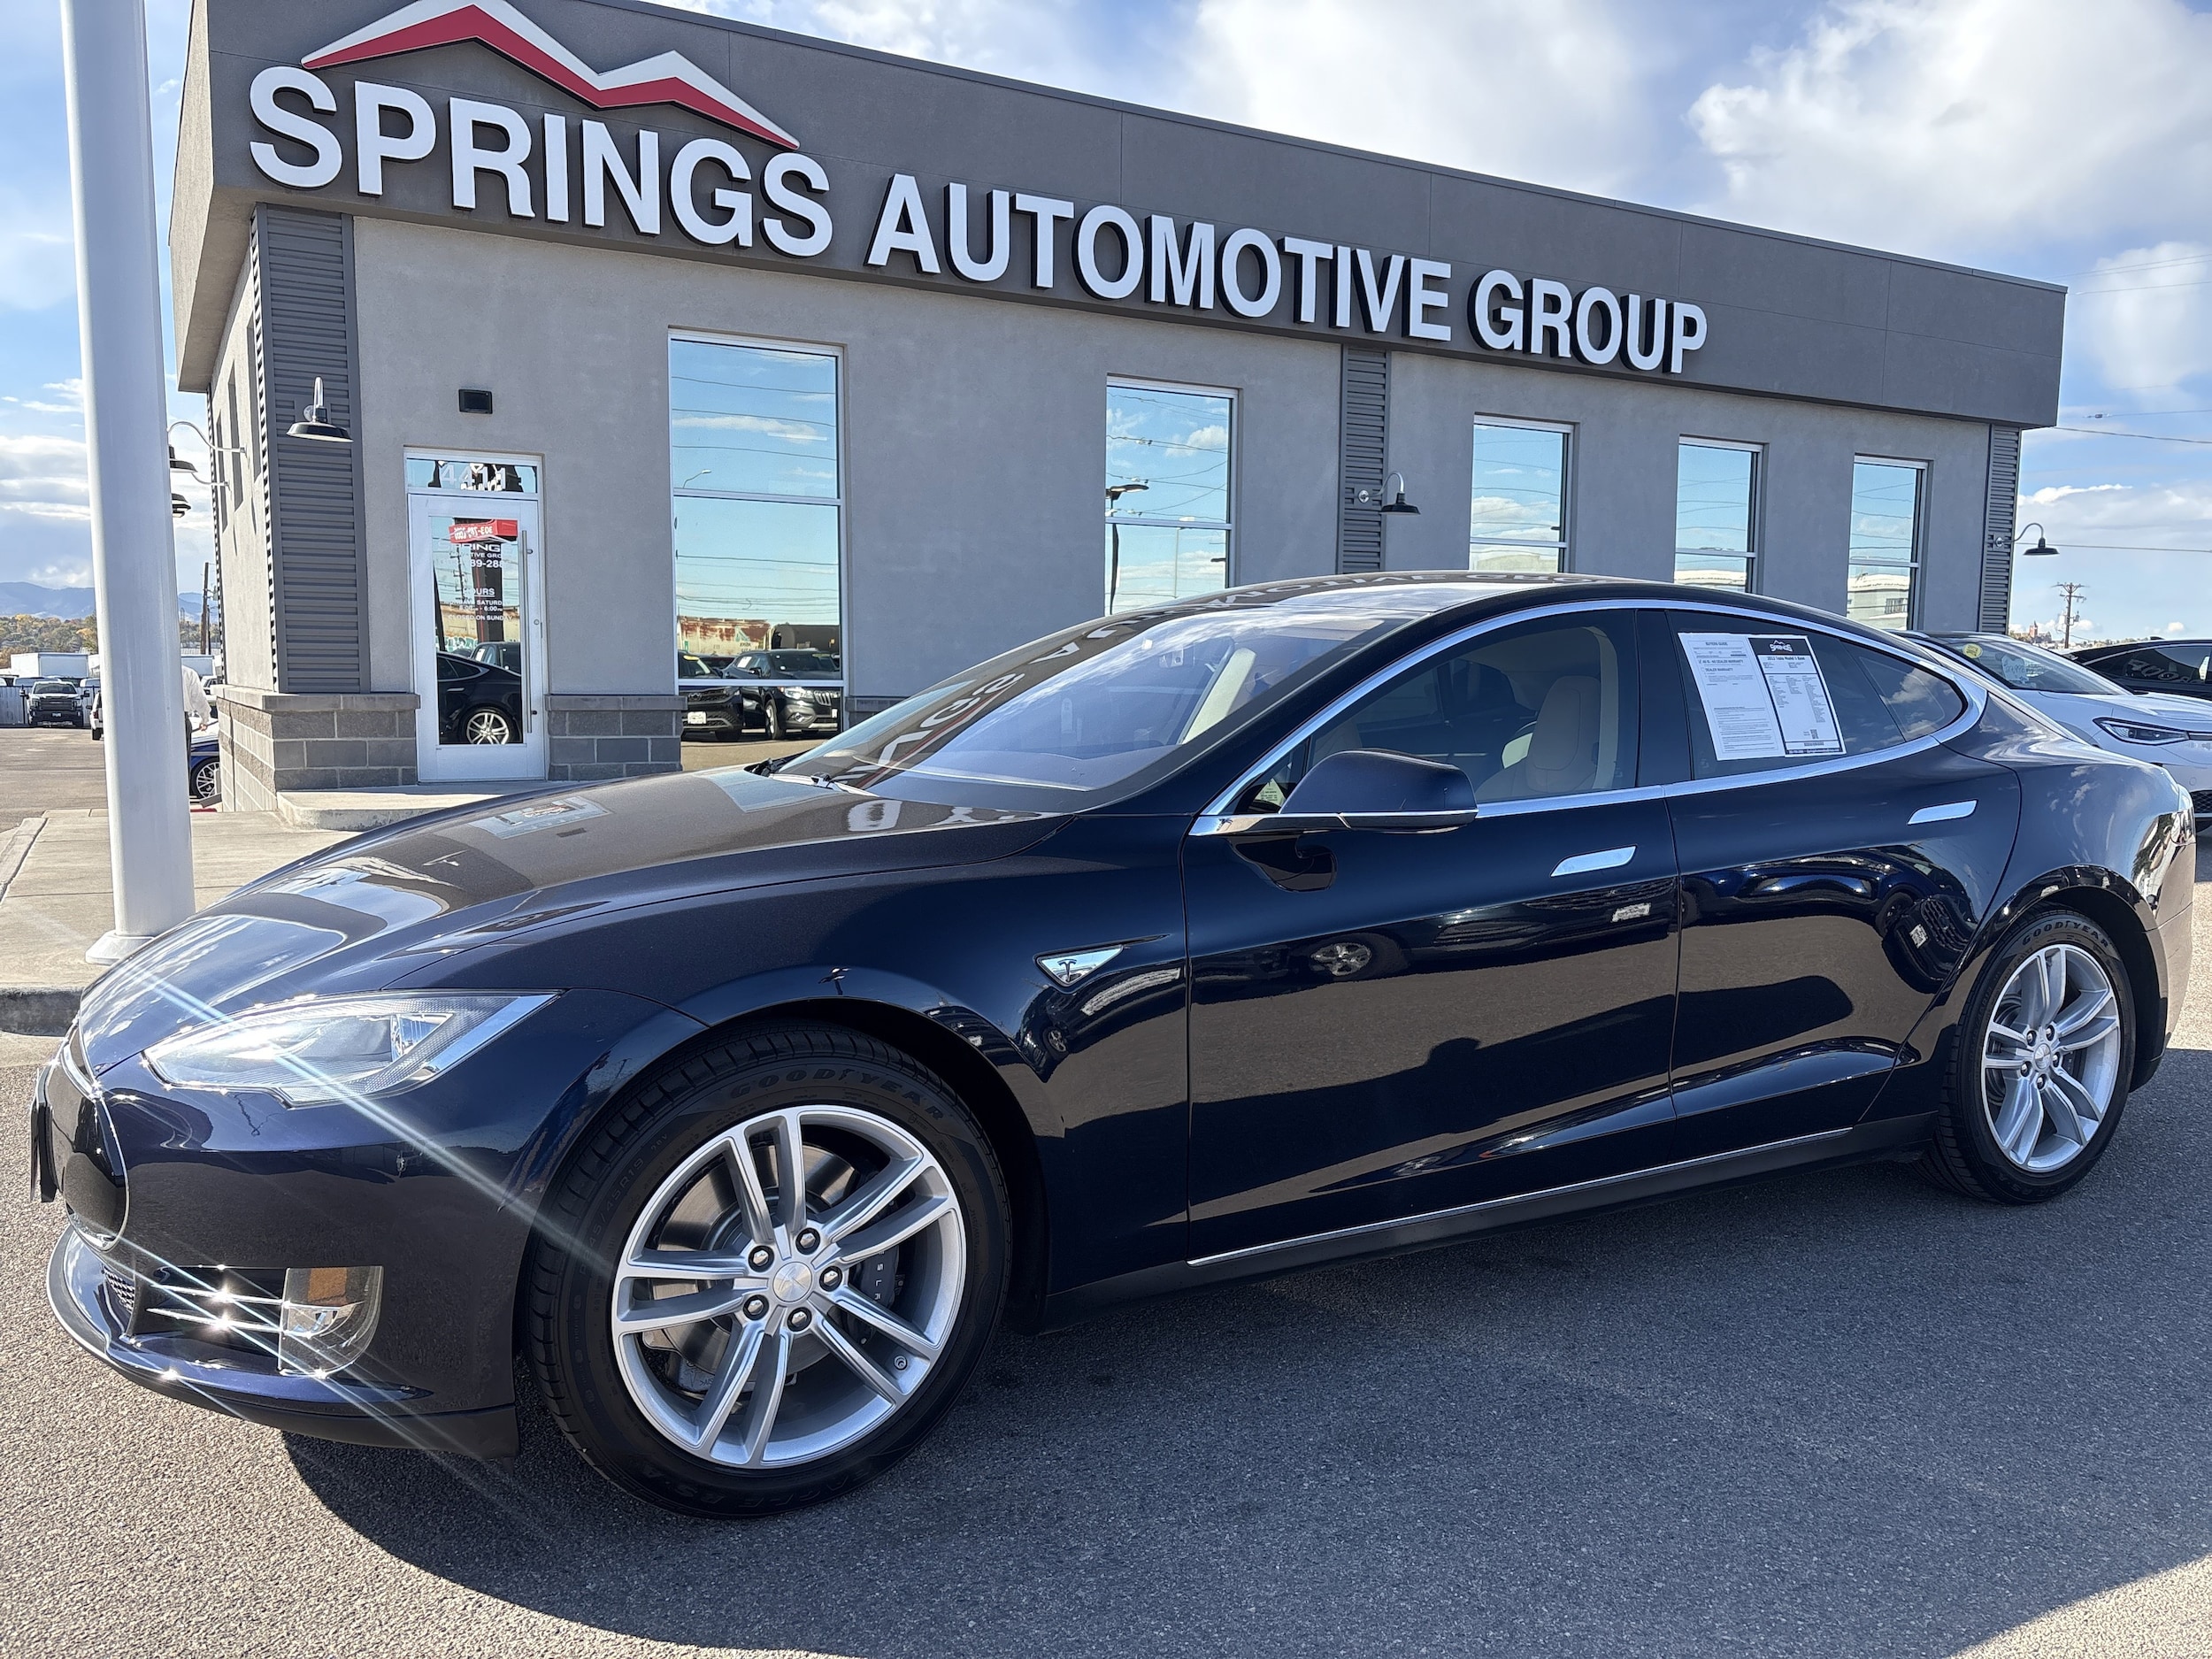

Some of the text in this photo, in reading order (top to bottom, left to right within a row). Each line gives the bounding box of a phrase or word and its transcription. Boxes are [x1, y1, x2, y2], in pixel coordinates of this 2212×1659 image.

[250, 65, 1708, 373] SPRINGS AUTOMOTIVE GROUP
[442, 464, 506, 489] 4411
[2022, 921, 2108, 948] GOODYEAR
[730, 1068, 944, 1120] GOODYEAR
